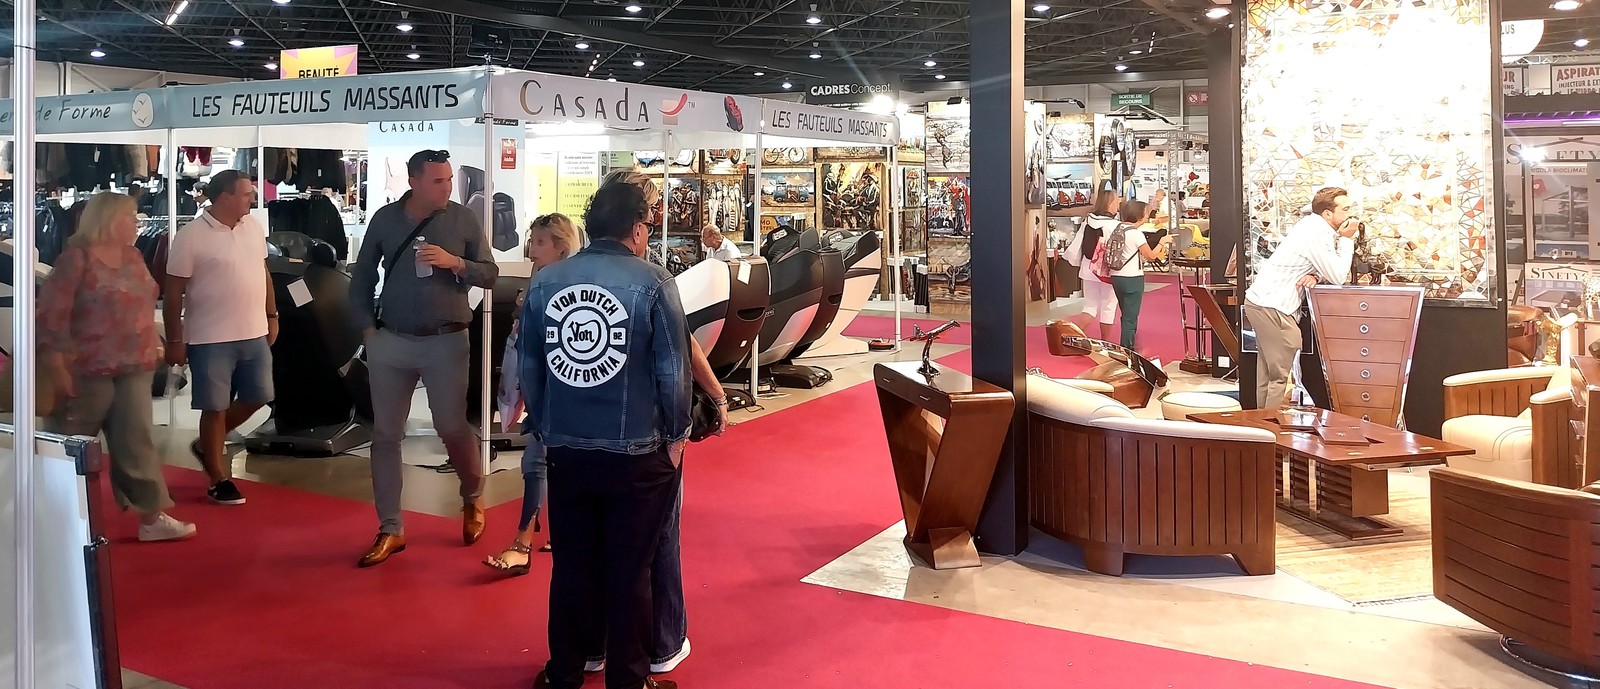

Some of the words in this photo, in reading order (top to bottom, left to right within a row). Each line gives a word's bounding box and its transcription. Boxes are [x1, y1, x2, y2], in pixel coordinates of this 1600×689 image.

[1556, 67, 1600, 81] ASPIRAT
[59, 99, 111, 122] Forme
[192, 95, 222, 117] LES
[232, 90, 331, 116] FAUTEUILS
[343, 84, 459, 111] MASSANTS
[772, 109, 791, 129] LES
[797, 113, 843, 134] FAUTEUILS
[848, 119, 887, 138] MASSANTS
[551, 291, 577, 312] VON
[580, 289, 619, 316] DUTCH
[567, 320, 600, 348] Von
[550, 354, 620, 383] CALIFORNIA
